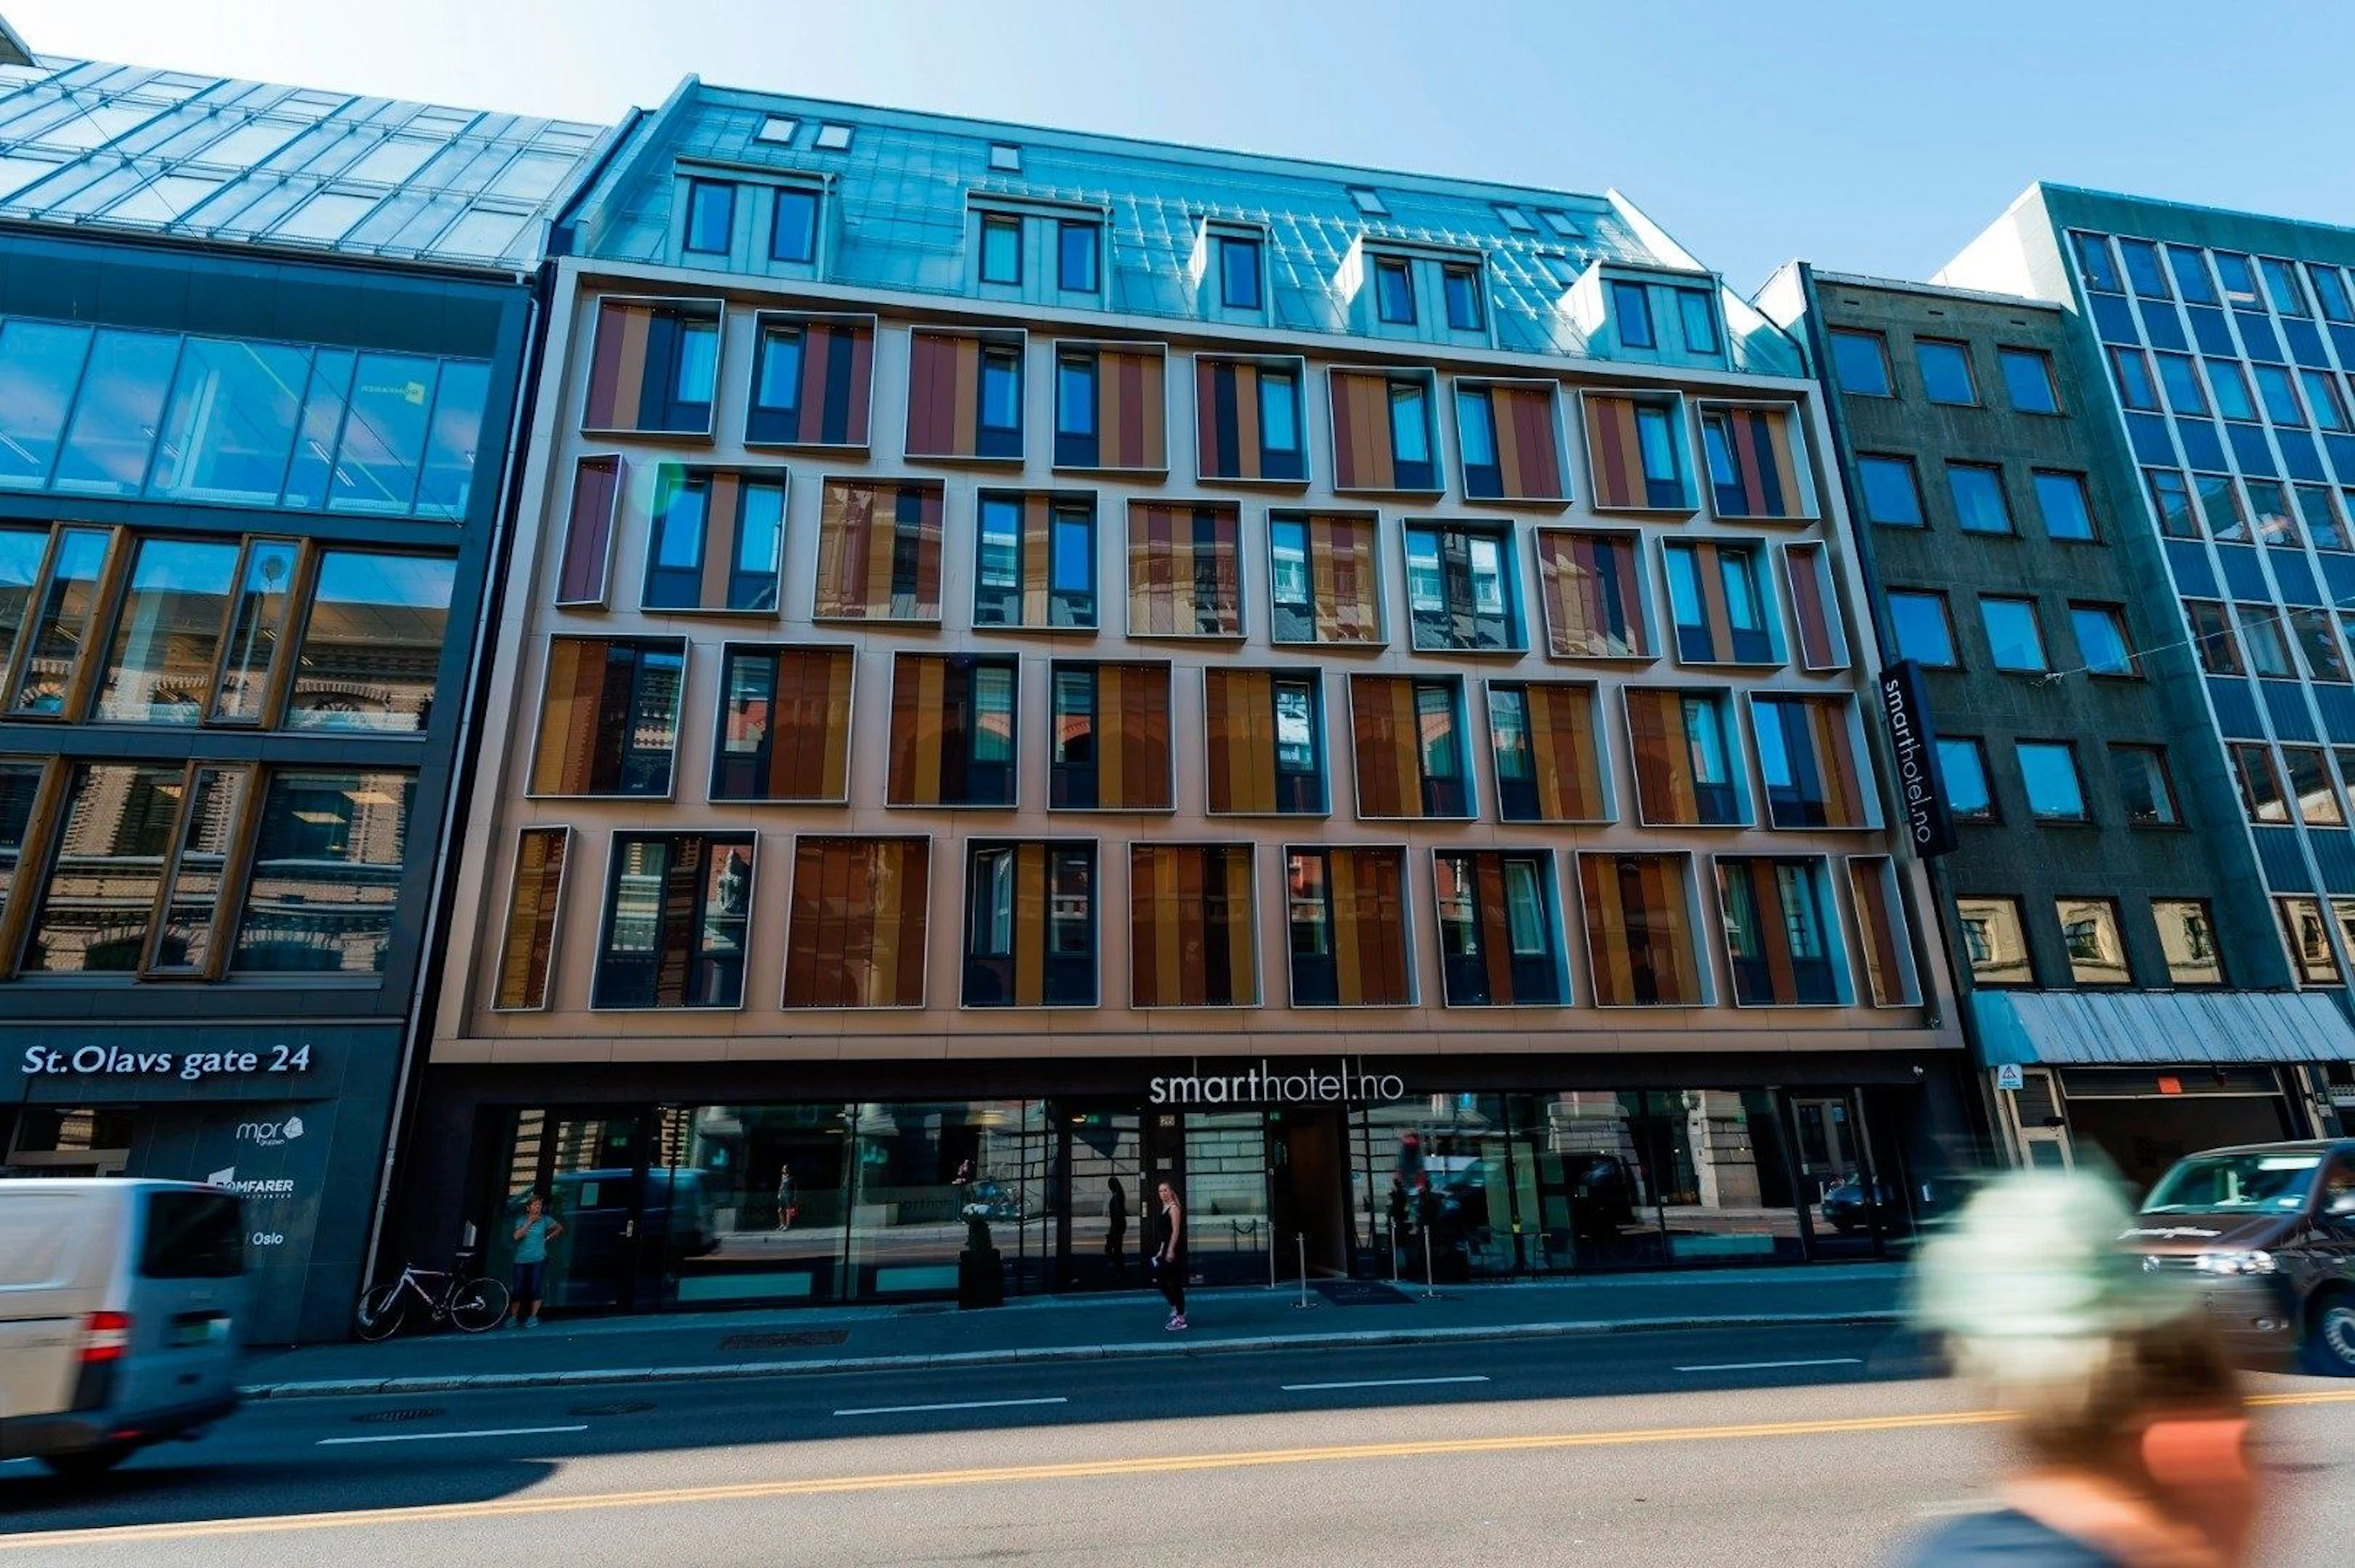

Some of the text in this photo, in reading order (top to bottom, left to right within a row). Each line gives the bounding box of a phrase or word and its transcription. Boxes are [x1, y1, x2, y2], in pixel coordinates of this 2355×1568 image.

[1885, 678, 1932, 843] smarthotel.no
[180, 1049, 258, 1080] gate
[268, 1044, 310, 1071] 24
[1149, 1058, 1404, 1103] smarthotel.no
[236, 1123, 283, 1144] mpr
[252, 1231, 285, 1245] Oslo
